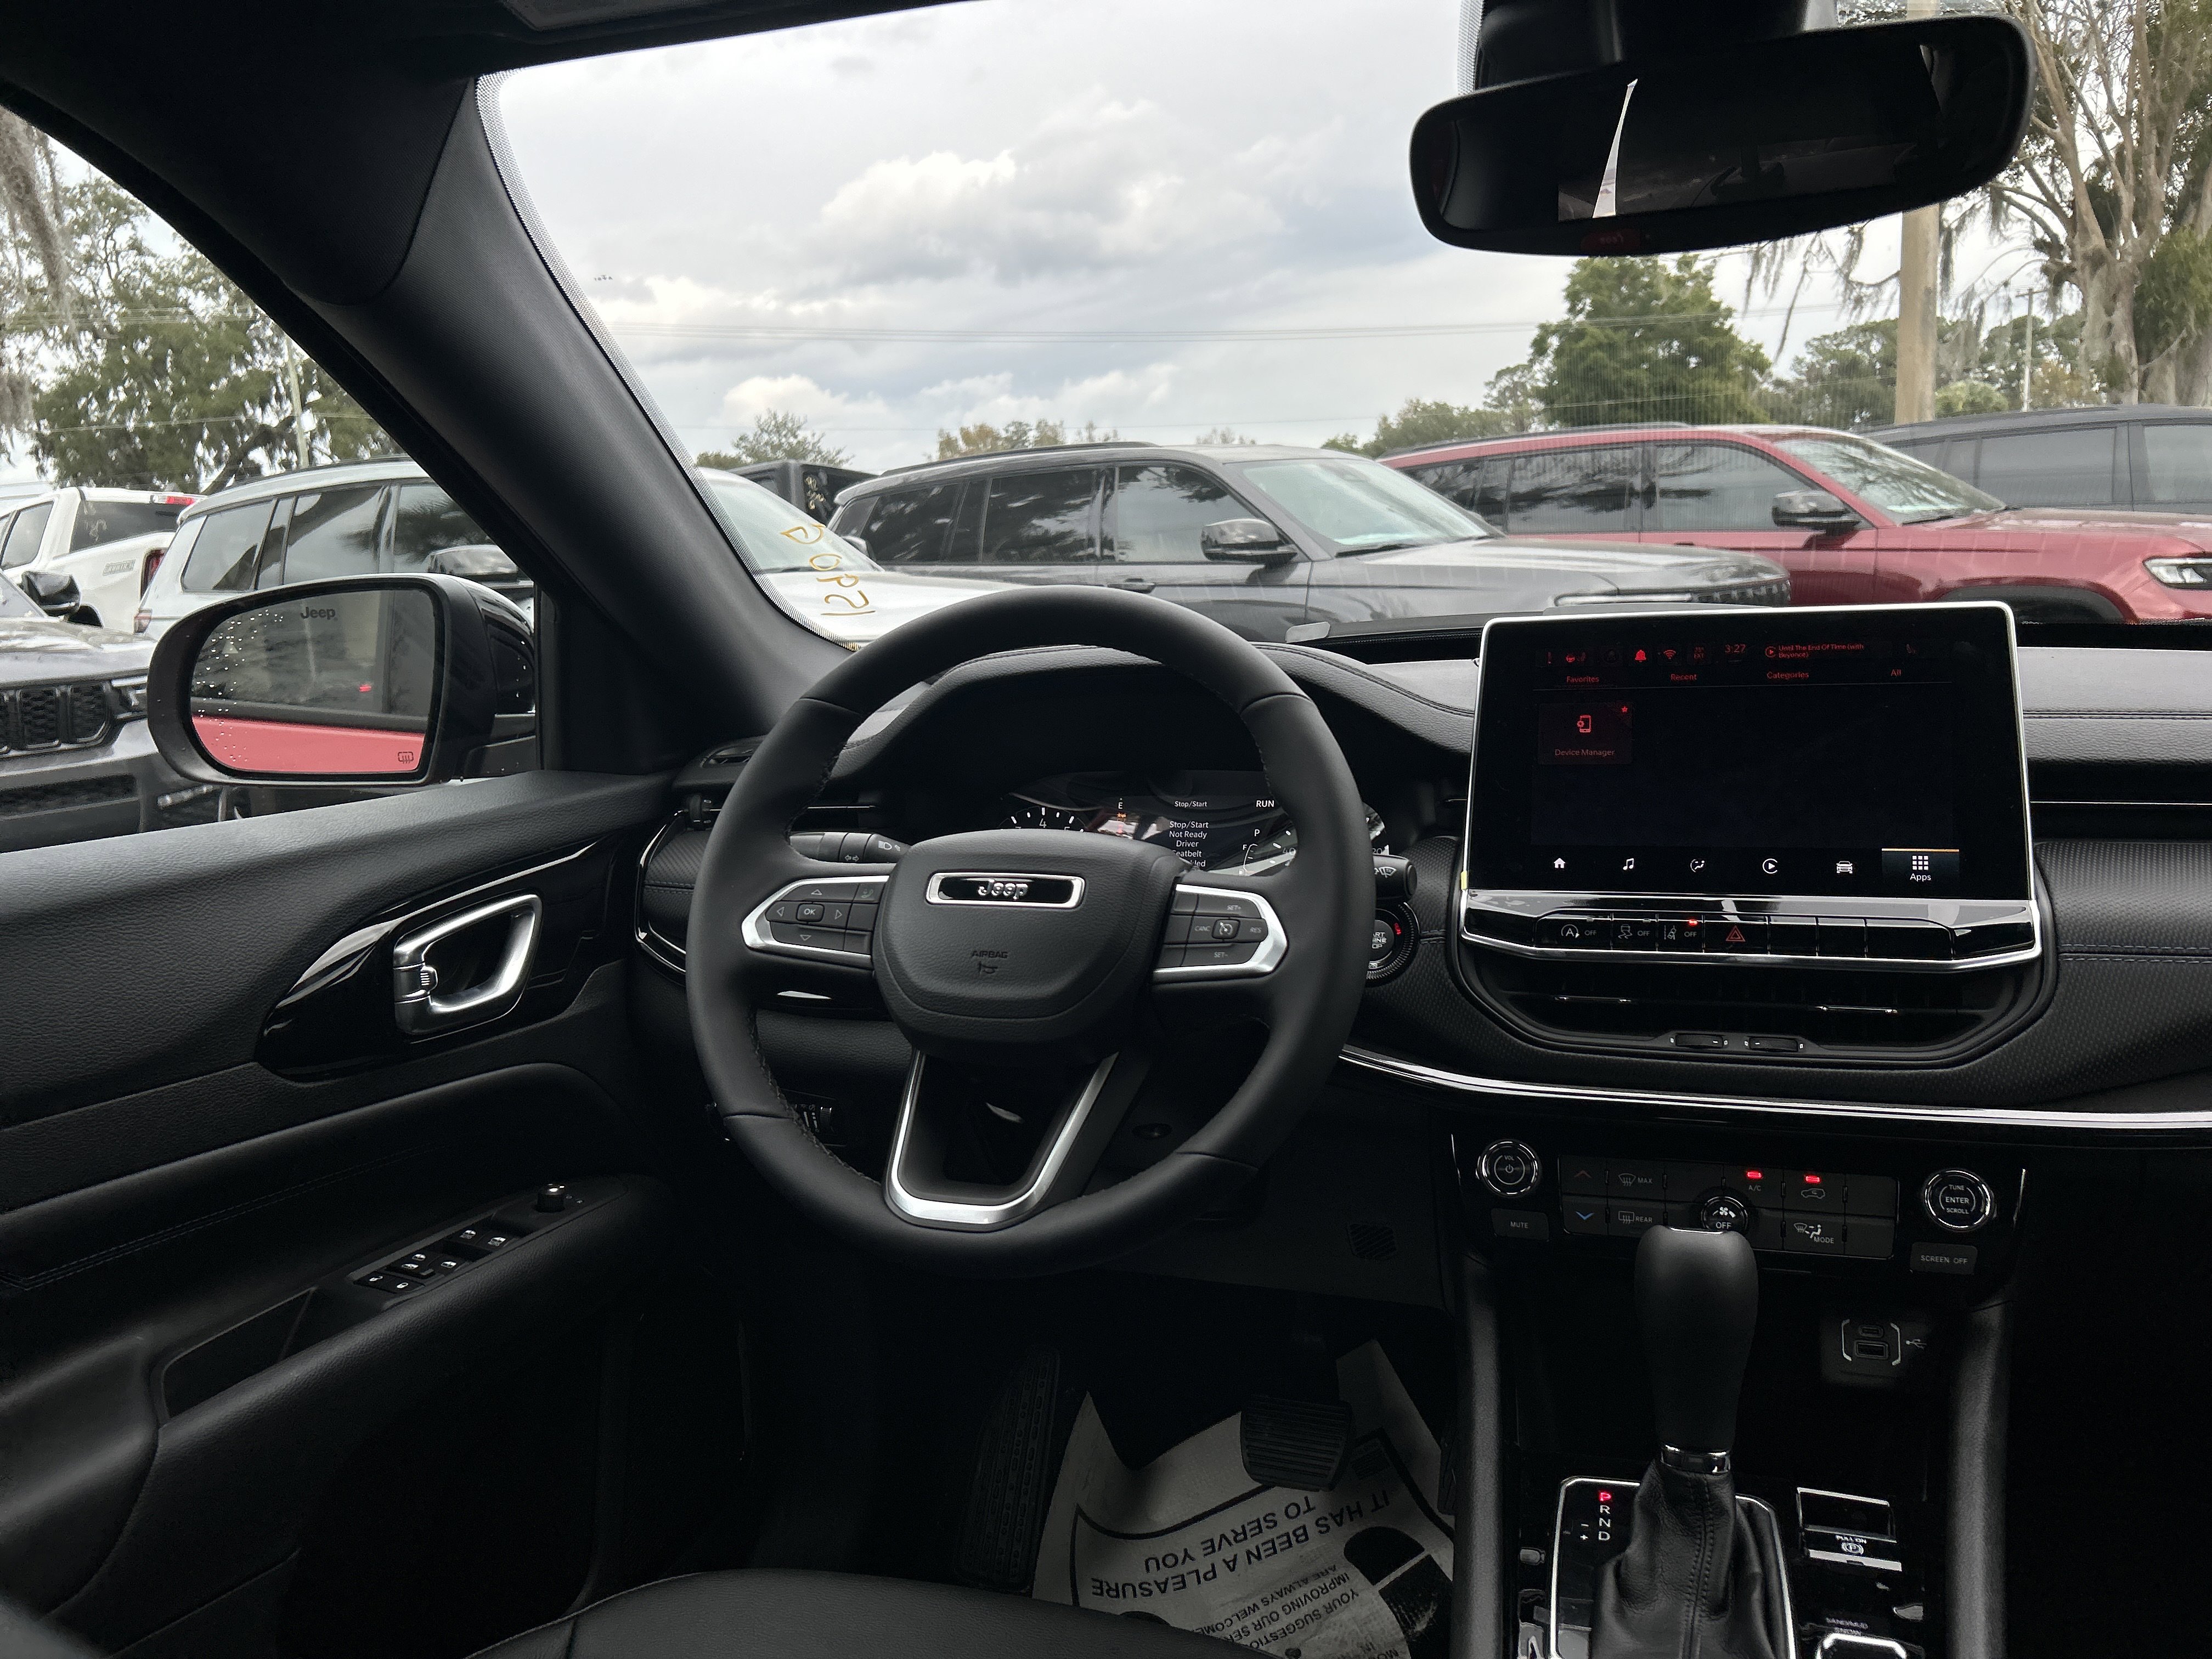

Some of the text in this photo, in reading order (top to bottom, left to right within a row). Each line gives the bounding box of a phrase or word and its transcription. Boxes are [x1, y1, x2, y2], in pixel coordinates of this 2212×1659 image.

[300, 607, 336, 620] Jeep
[1725, 644, 1746, 654] 3:27
[1670, 673, 1697, 681] Recent
[1767, 670, 1809, 680] Categories
[1891, 668, 1902, 677] All
[1566, 675, 1600, 683] Favorites
[1581, 748, 1615, 758] Manager
[1256, 800, 1275, 808] RUN
[1039, 818, 1047, 828] 4
[1169, 821, 1209, 830] Stop/Start
[1184, 830, 1207, 839] Ready
[1255, 829, 1260, 837] P
[1910, 873, 1932, 882] Apps
[978, 878, 1029, 900] Jeep
[971, 950, 1008, 958] AIRBAG
[1814, 1236, 1835, 1244] MODE
[1921, 1255, 1950, 1263] SCREEN
[1599, 1492, 1612, 1502] P
[1599, 1504, 1611, 1514] R
[1599, 1517, 1611, 1528] N
[1145, 1496, 1316, 1573] TO SERVE YOU
[1598, 1531, 1611, 1541] D
[1091, 1491, 1390, 1599] IT HAS BEEN A PLEASURE
[1261, 1577, 1309, 1606] ALWAYS
[1282, 1573, 1350, 1615] IMPROVING
[1250, 1588, 1359, 1648] YOUR SUGGESTIO
[1251, 1610, 1280, 1633] OUR
